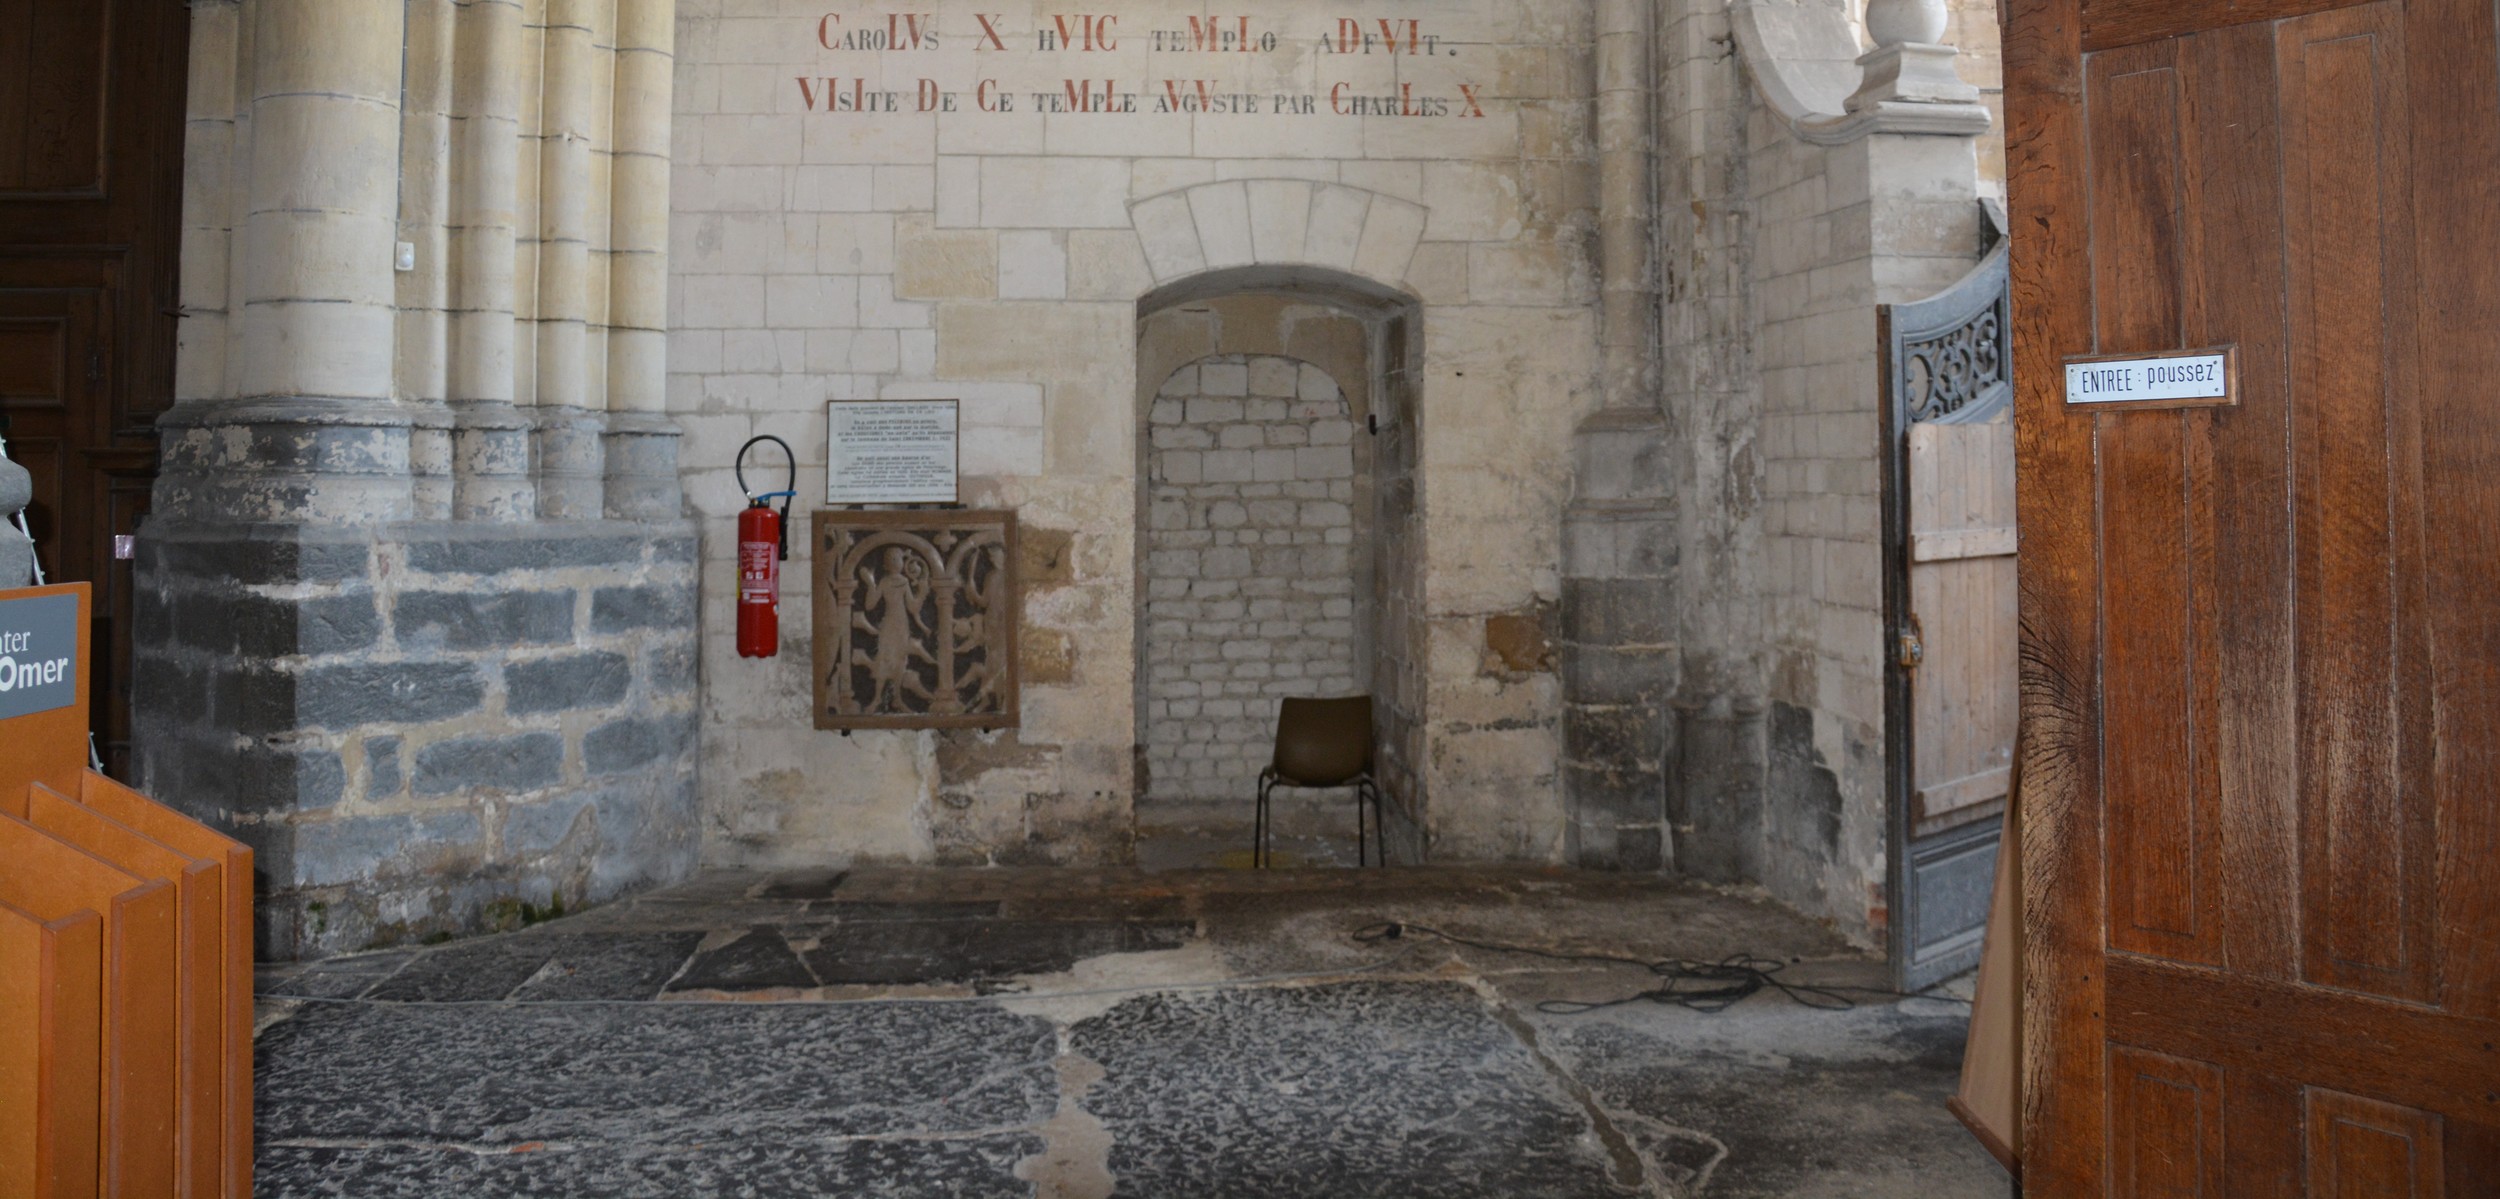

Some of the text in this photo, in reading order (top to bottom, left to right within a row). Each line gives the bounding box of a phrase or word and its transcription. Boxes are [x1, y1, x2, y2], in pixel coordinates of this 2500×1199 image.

[973, 13, 1009, 52] X
[1273, 94, 1316, 116] PAR
[1457, 83, 1486, 118] X
[2082, 368, 2133, 394] ENTREE
[2147, 363, 2214, 390] poussez
